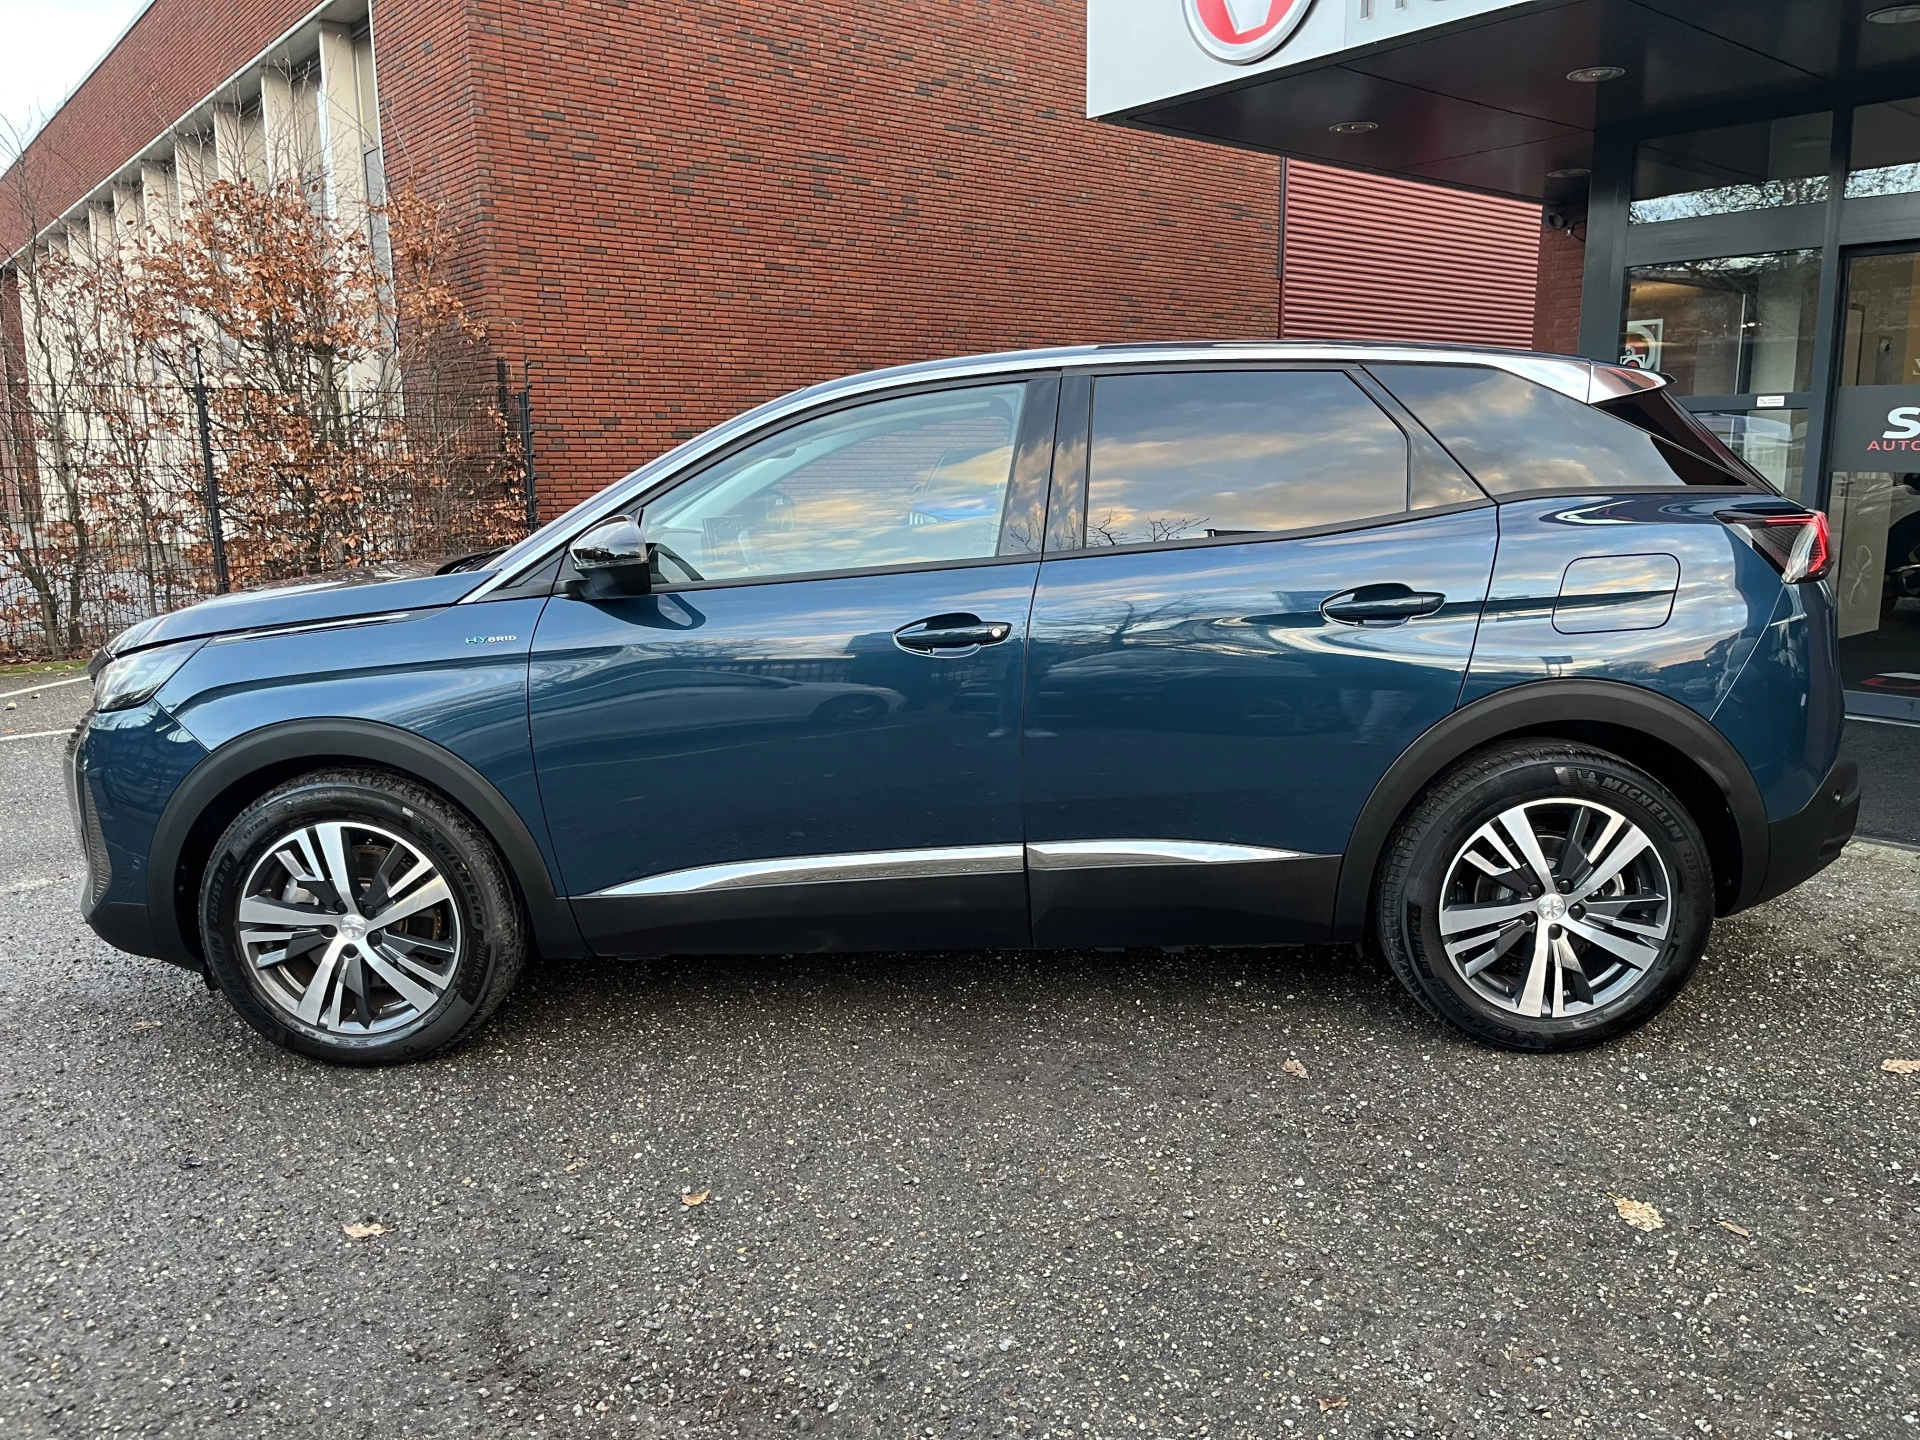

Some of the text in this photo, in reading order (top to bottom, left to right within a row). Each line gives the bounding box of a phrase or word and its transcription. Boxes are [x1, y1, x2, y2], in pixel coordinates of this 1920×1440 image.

[465, 635, 517, 645] HYBRID
[1602, 777, 1683, 839] MICHELIN
[436, 841, 485, 925] MICHELIN
[468, 938, 487, 990] PRIMACY
[1412, 918, 1430, 969] PRIMACY
